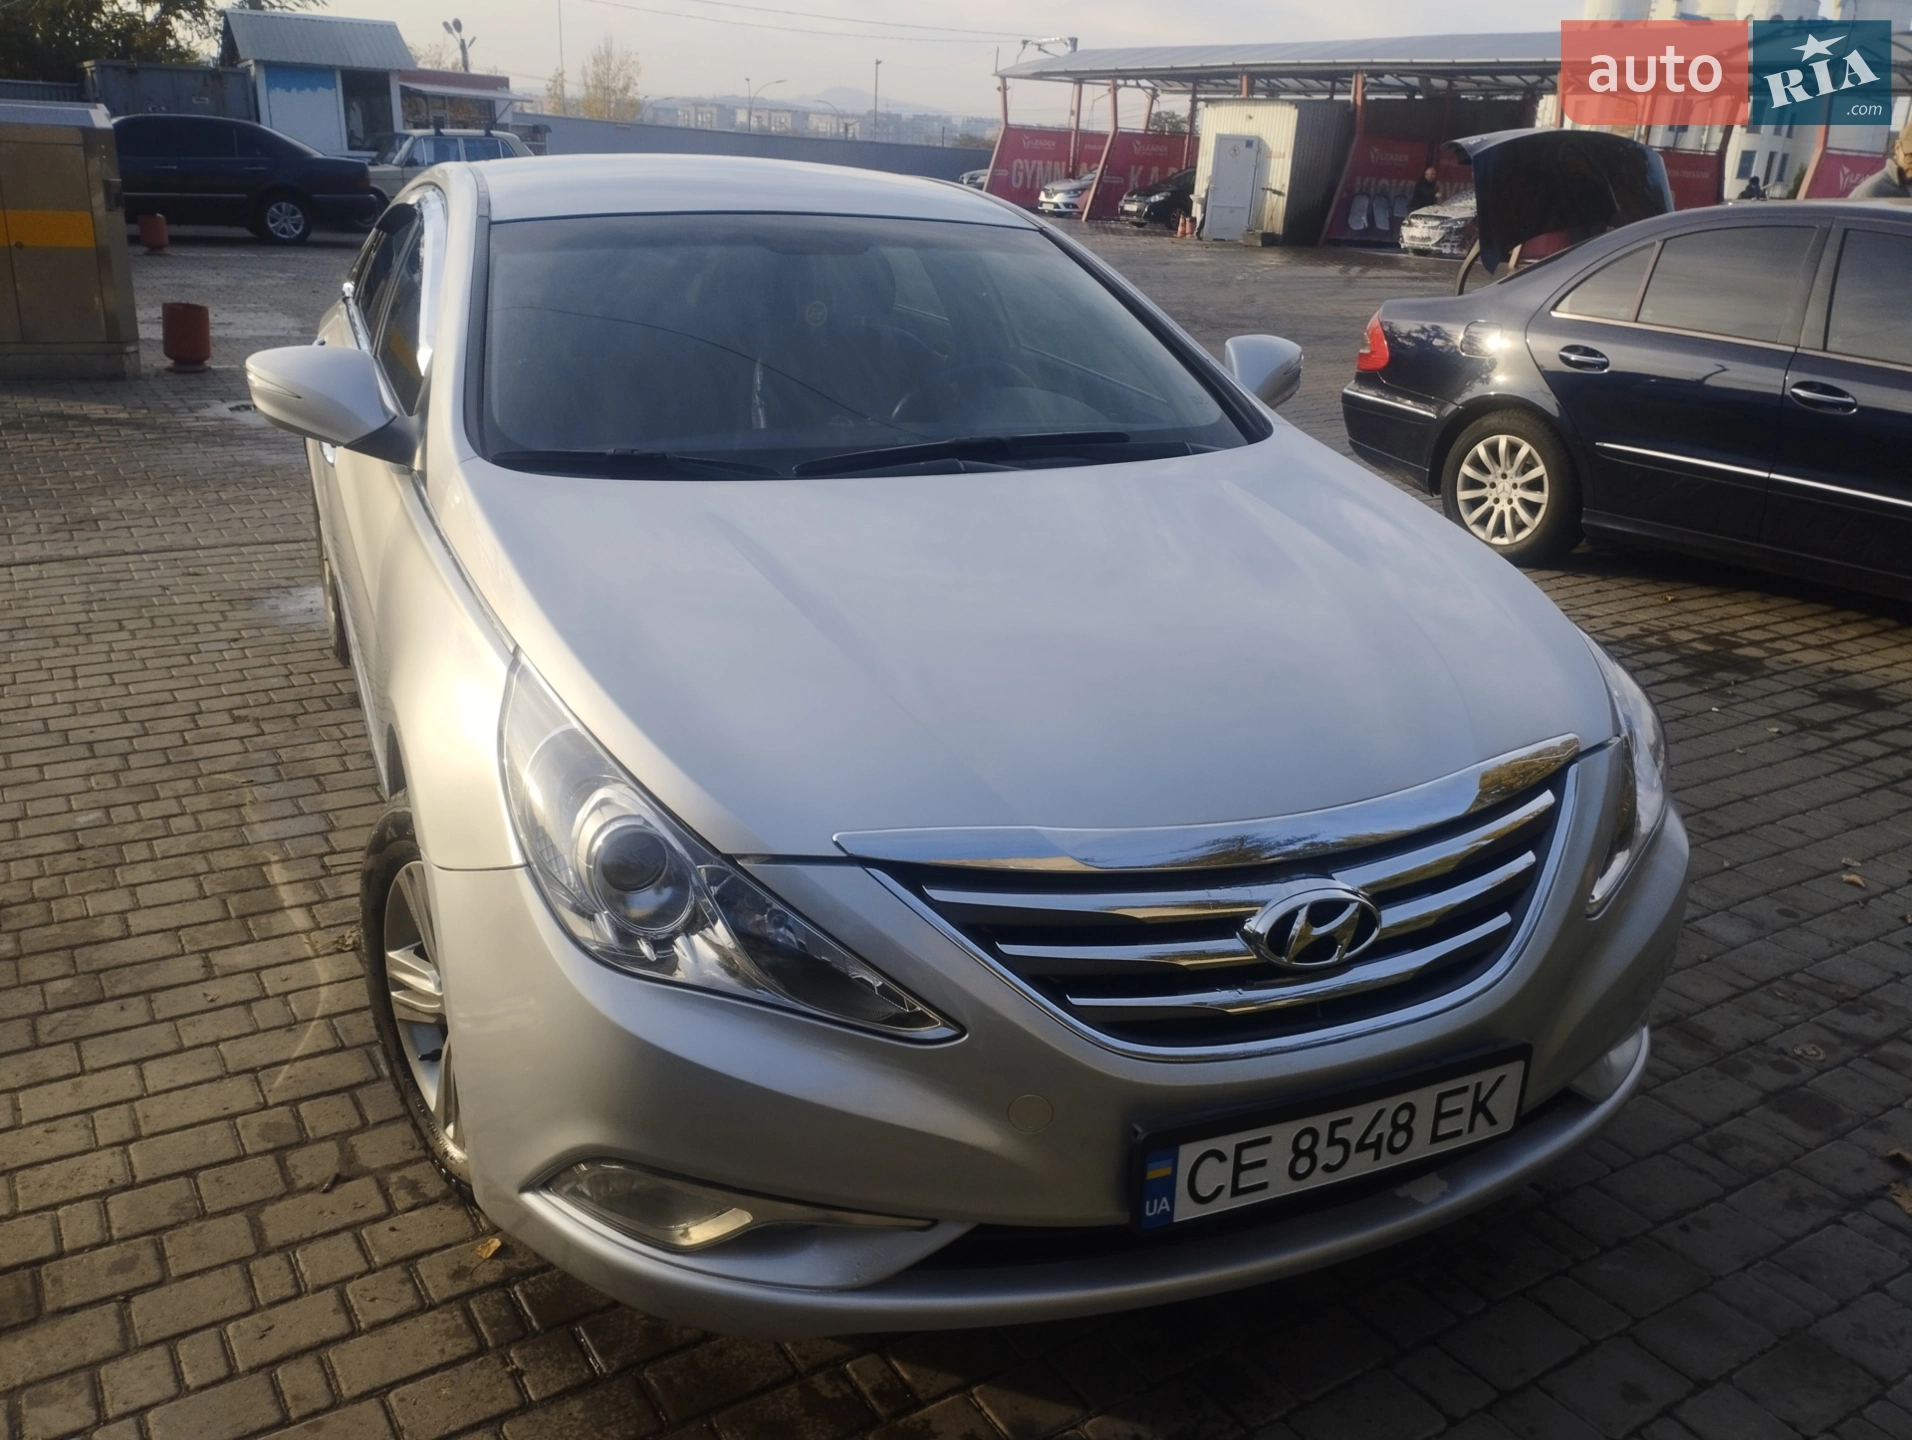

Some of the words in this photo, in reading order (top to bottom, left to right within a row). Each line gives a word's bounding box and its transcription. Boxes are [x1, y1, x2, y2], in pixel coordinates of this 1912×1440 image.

[1187, 1134, 1273, 1206] CE
[1287, 1101, 1417, 1181] 8548
[1429, 1074, 1508, 1145] EK
[1145, 1196, 1171, 1217] UA
